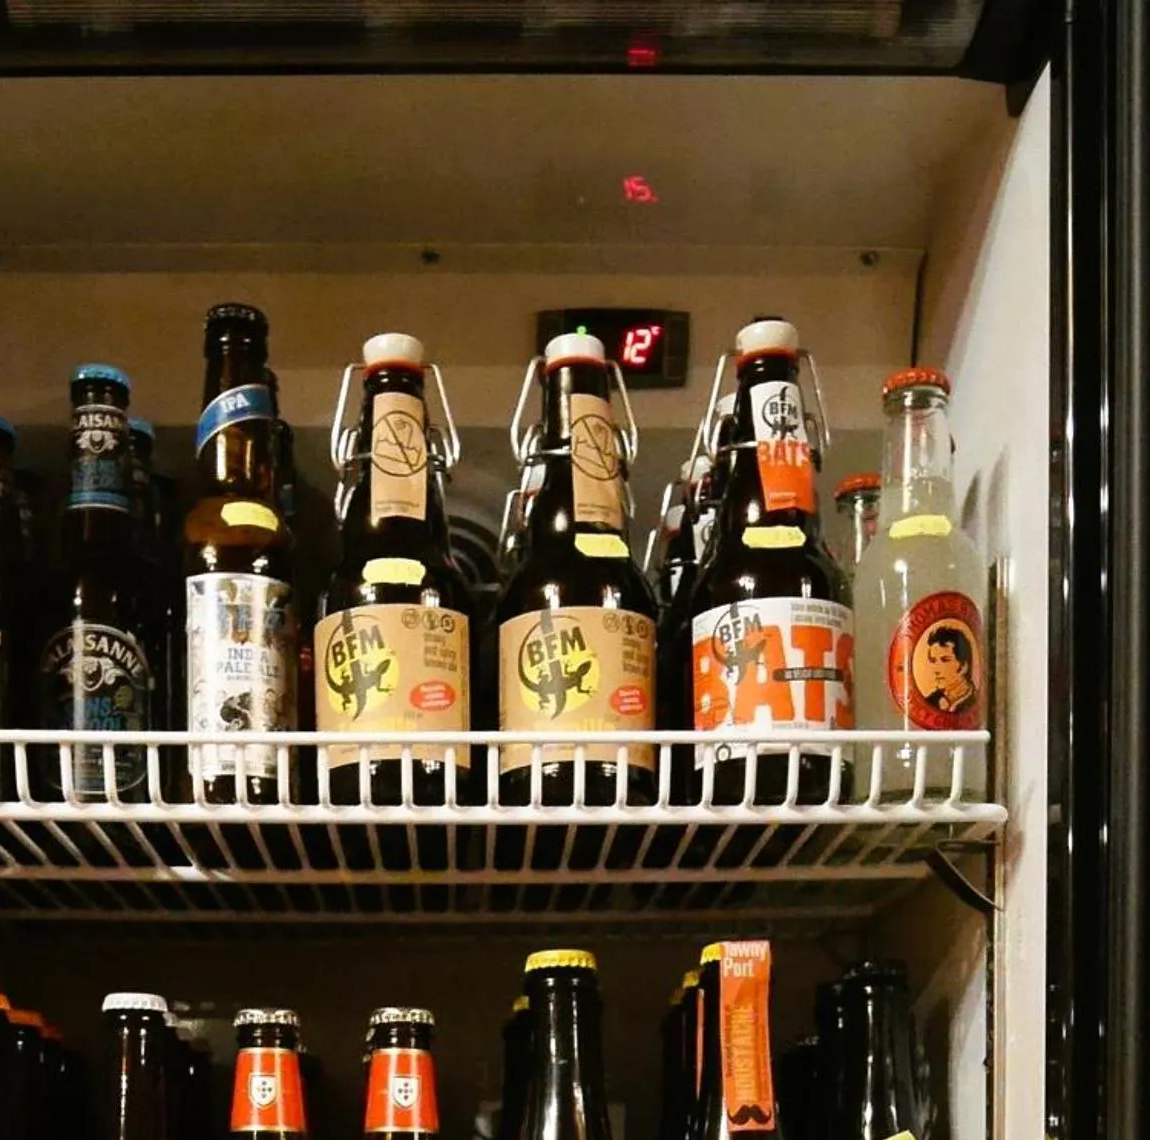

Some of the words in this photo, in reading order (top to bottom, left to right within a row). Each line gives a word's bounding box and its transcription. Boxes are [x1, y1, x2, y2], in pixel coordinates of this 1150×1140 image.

[219, 392, 250, 413] IPA
[719, 613, 763, 644] BFM
[332, 624, 385, 668] BFM
[527, 626, 587, 668] BFM
[723, 957, 755, 978] Port
